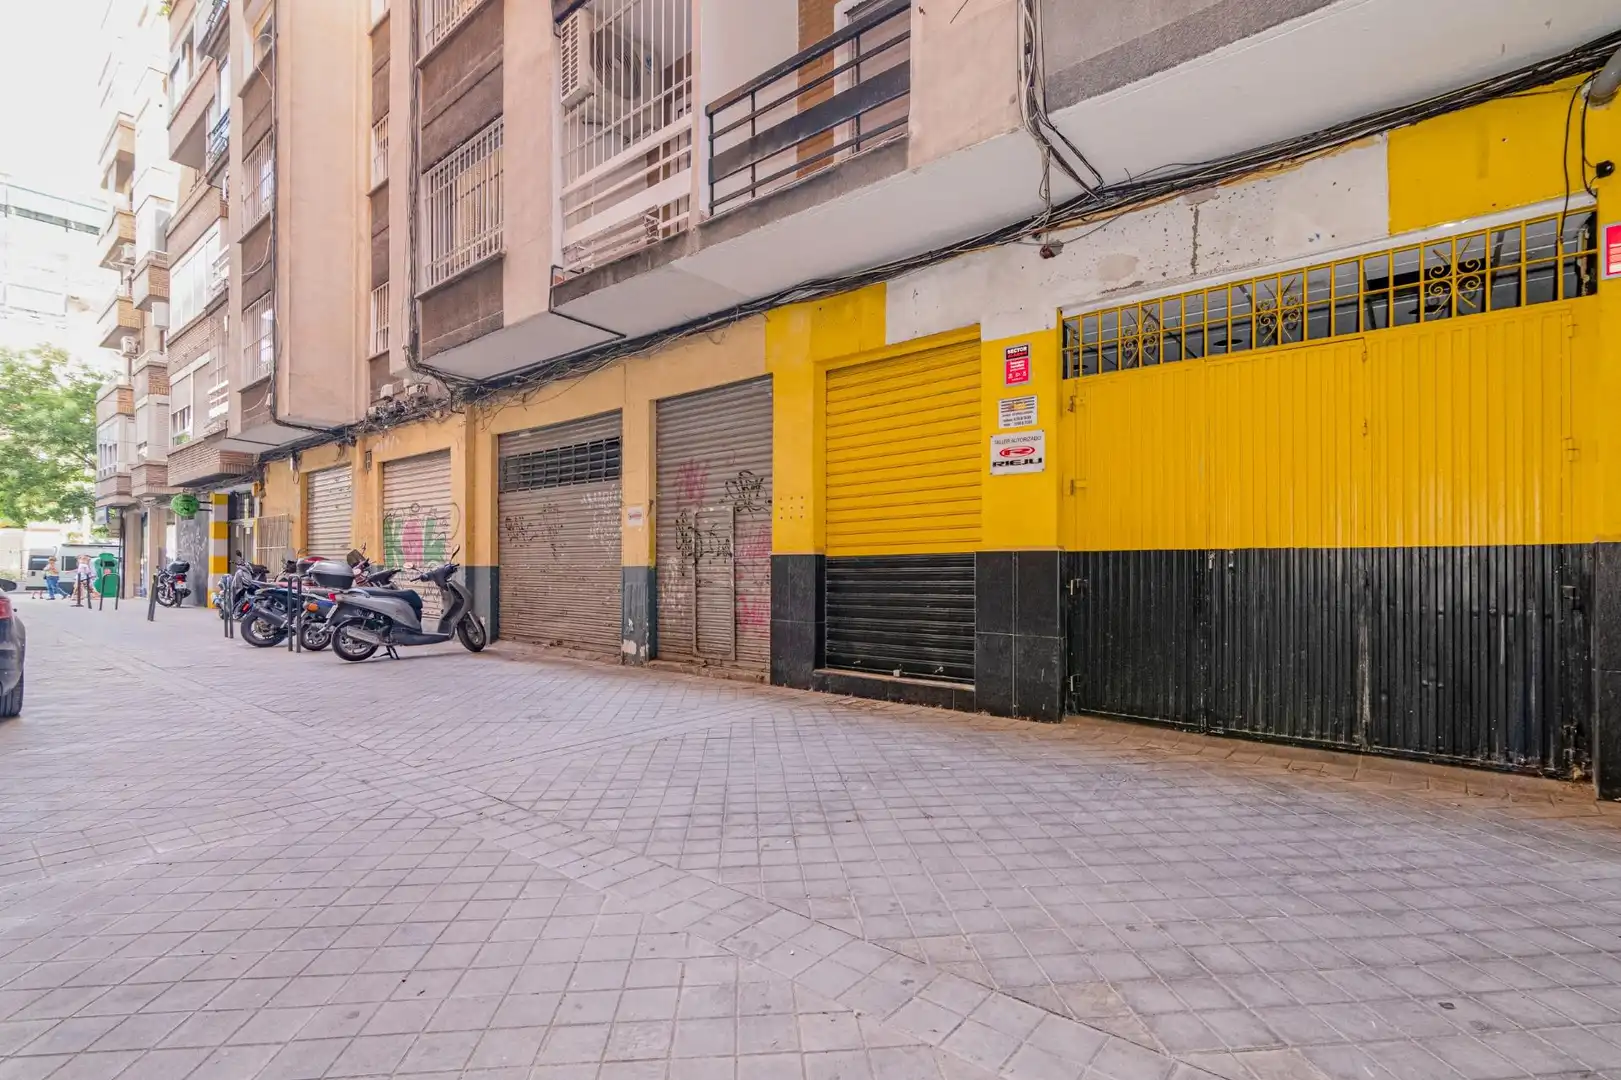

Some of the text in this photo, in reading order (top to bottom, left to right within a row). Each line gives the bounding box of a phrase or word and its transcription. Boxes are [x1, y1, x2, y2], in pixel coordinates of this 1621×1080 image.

[1007, 346, 1027, 354] SECTOR
[1011, 435, 1042, 443] AUTORIZADO
[992, 457, 1042, 467] RIEJU
